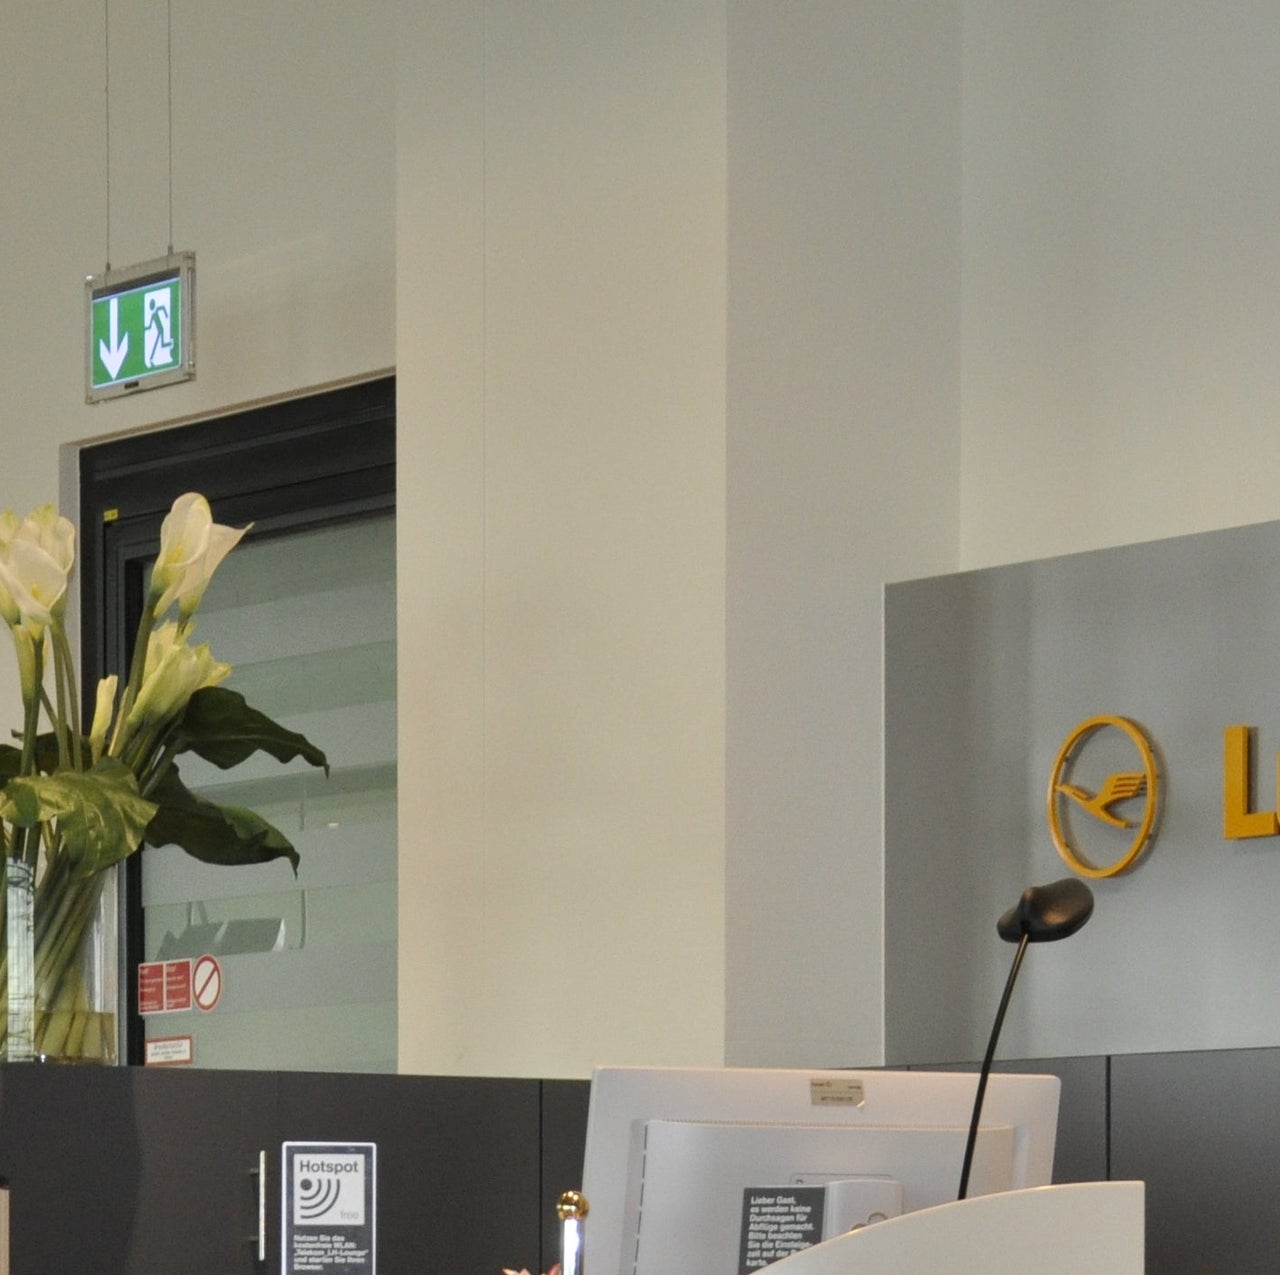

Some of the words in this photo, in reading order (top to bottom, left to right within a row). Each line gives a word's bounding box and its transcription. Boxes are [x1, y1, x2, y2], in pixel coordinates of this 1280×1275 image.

[299, 1160, 359, 1175] Hotspot
[751, 1196, 775, 1204] Lieber
[776, 1196, 796, 1205] Gast,
[761, 1205, 789, 1213] werden
[790, 1205, 812, 1213] keine
[340, 1210, 359, 1219] free
[749, 1214, 795, 1223] Durchsagen
[796, 1214, 808, 1222] für
[749, 1223, 779, 1232] Abflüge
[780, 1223, 814, 1232] gemacht.
[293, 1234, 318, 1242] Nutzen
[319, 1234, 331, 1242] Sie
[332, 1234, 345, 1242] das
[748, 1232, 767, 1240] Bitte
[767, 1232, 803, 1240] beachten
[747, 1241, 761, 1249] Sie
[761, 1241, 774, 1249] die
[747, 1250, 761, 1258] zeit
[761, 1250, 775, 1258] auf
[776, 1250, 789, 1258] der
